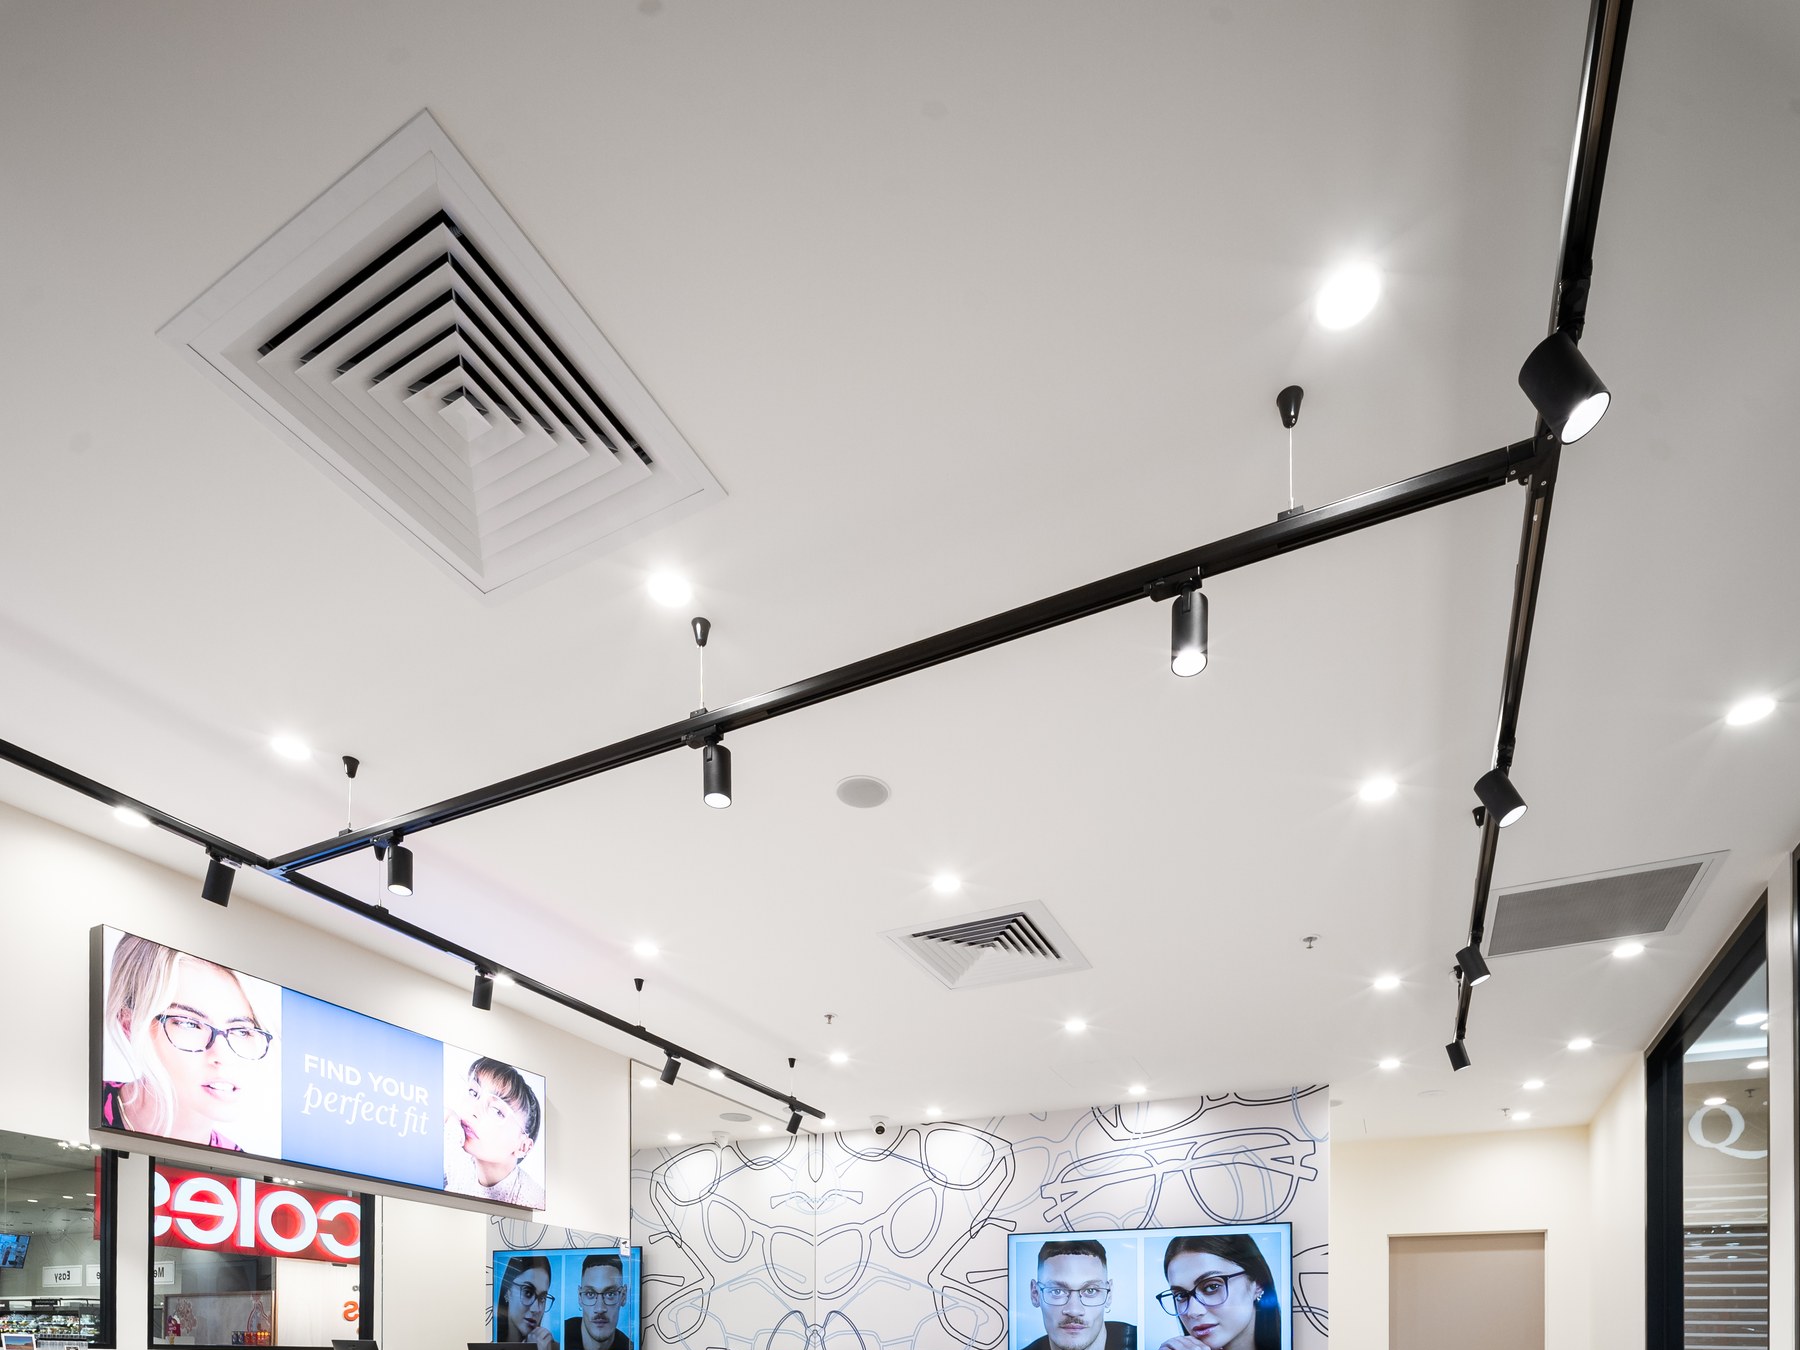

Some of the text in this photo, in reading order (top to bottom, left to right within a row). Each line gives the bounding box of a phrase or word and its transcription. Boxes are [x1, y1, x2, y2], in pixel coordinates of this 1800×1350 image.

[304, 1053, 429, 1106] FIND YOUR
[300, 1082, 430, 1137] perfect fit
